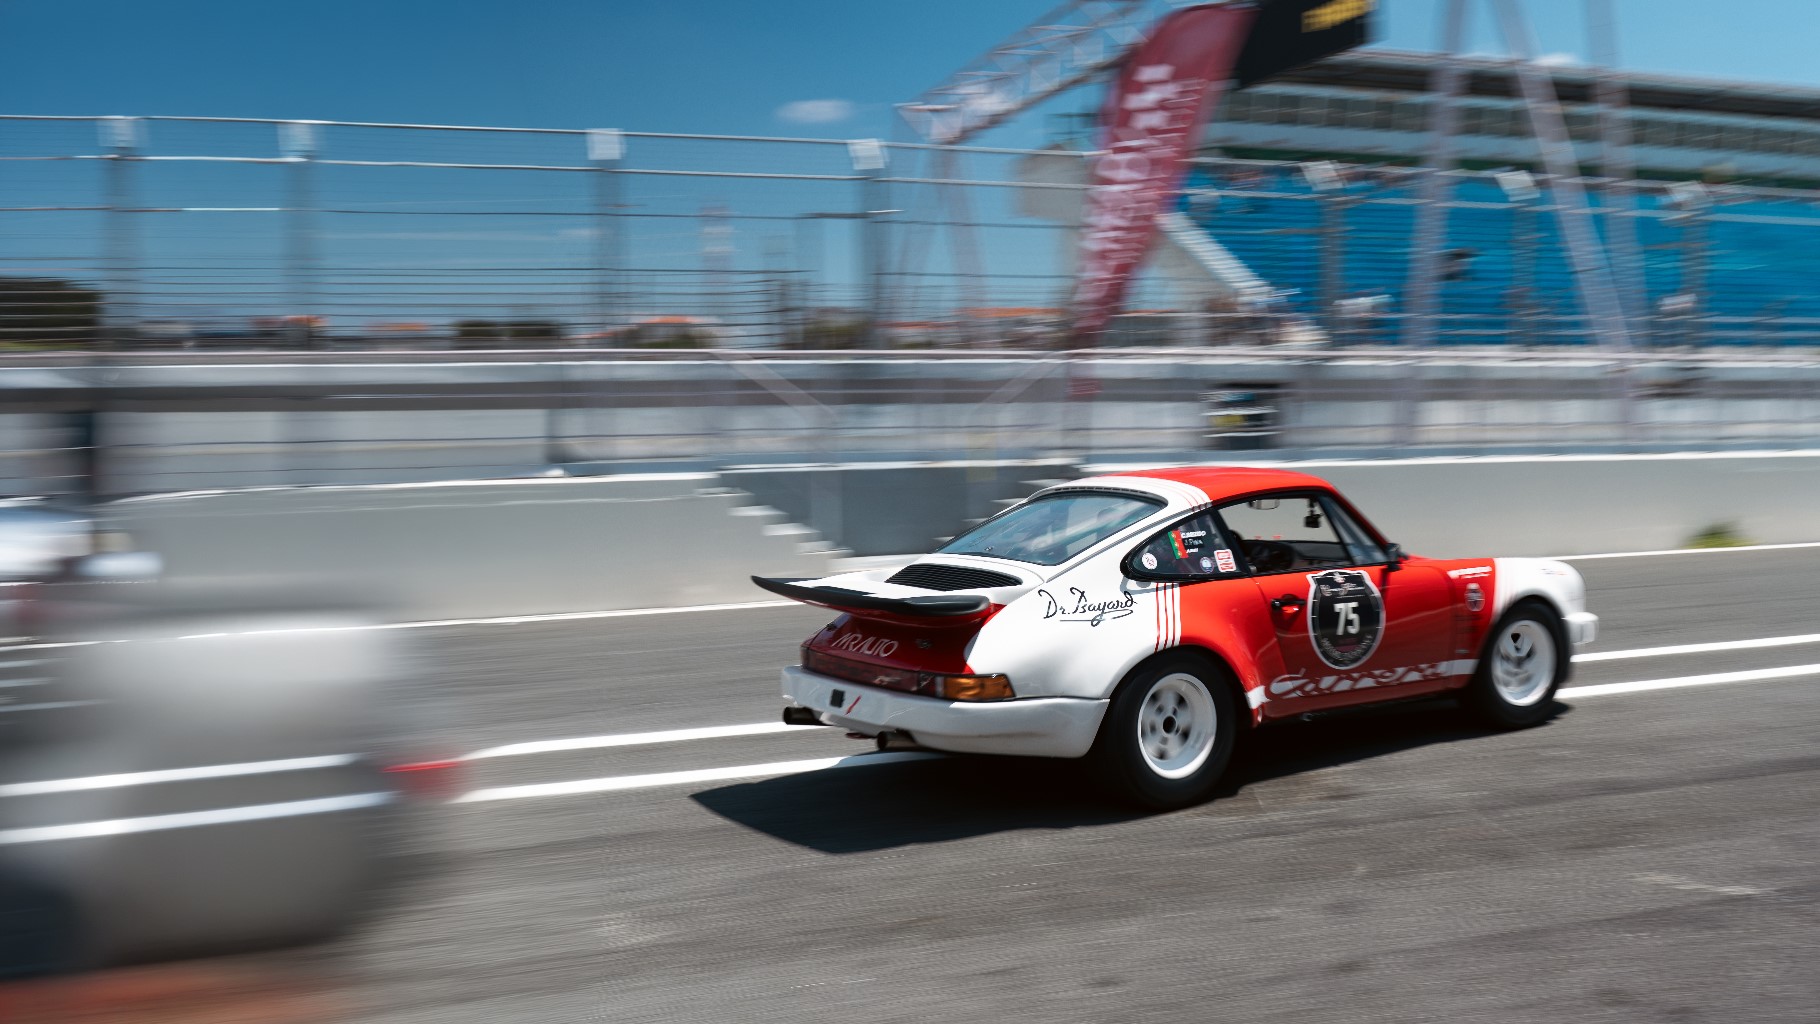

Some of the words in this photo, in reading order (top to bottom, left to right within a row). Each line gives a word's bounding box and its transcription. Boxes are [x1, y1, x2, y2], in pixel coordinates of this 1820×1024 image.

[1037, 588, 1071, 620] Dr.
[1069, 586, 1137, 628] Bayard
[1332, 601, 1361, 636] 75
